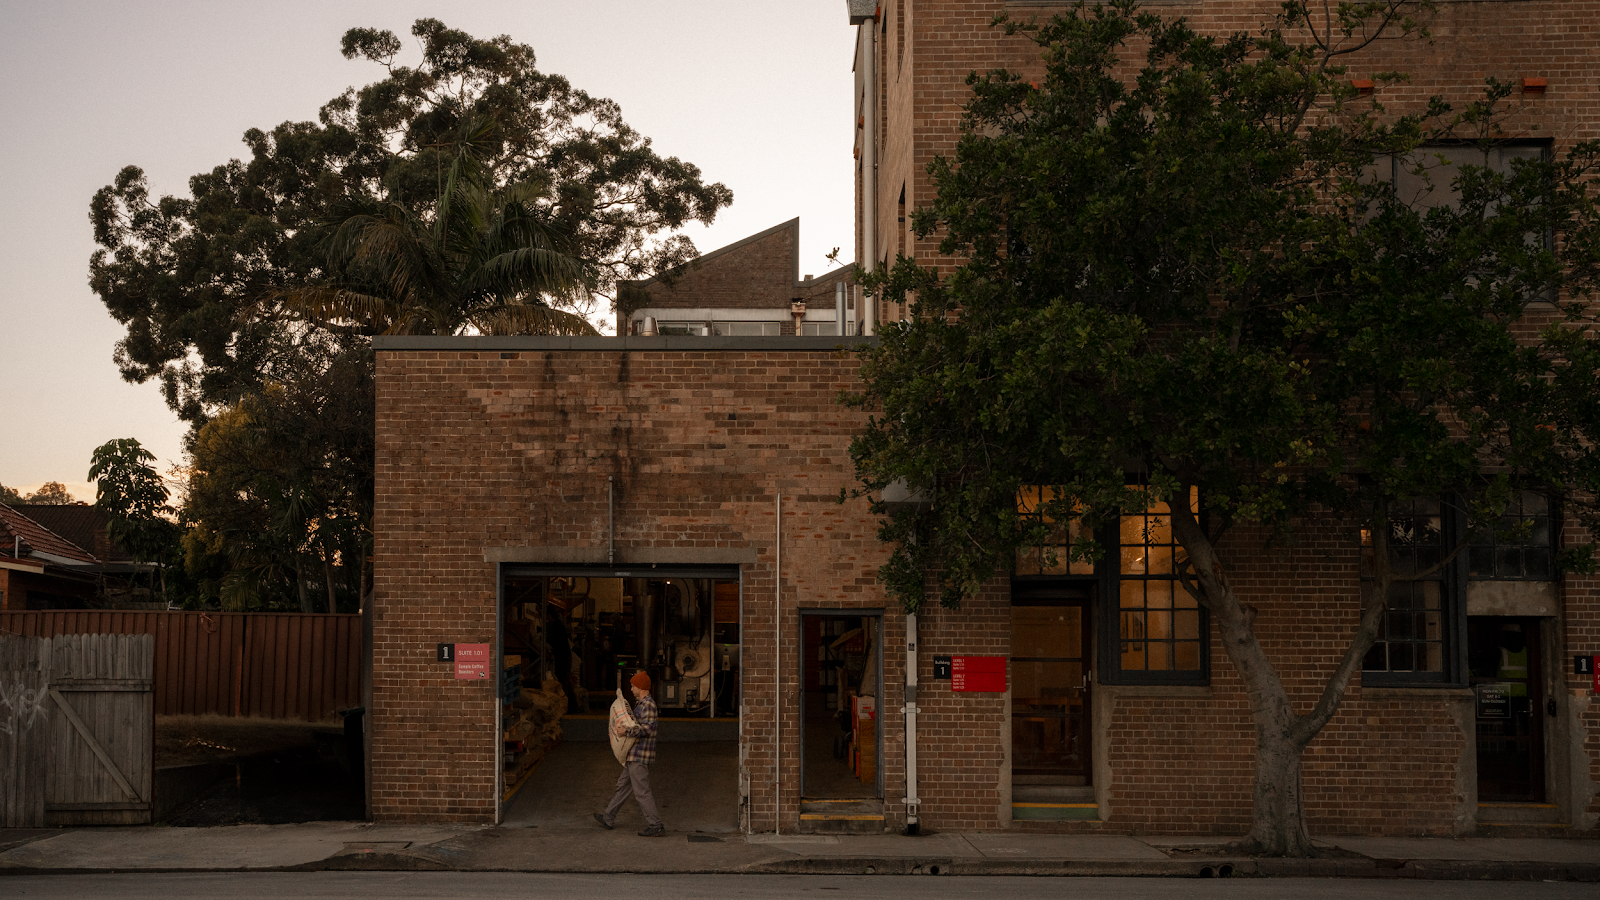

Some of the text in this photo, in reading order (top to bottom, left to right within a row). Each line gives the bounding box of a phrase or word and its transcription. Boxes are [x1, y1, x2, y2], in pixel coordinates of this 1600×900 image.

[443, 646, 449, 659] 1
[941, 667, 945, 675] 1
[1580, 658, 1588, 672] 1
